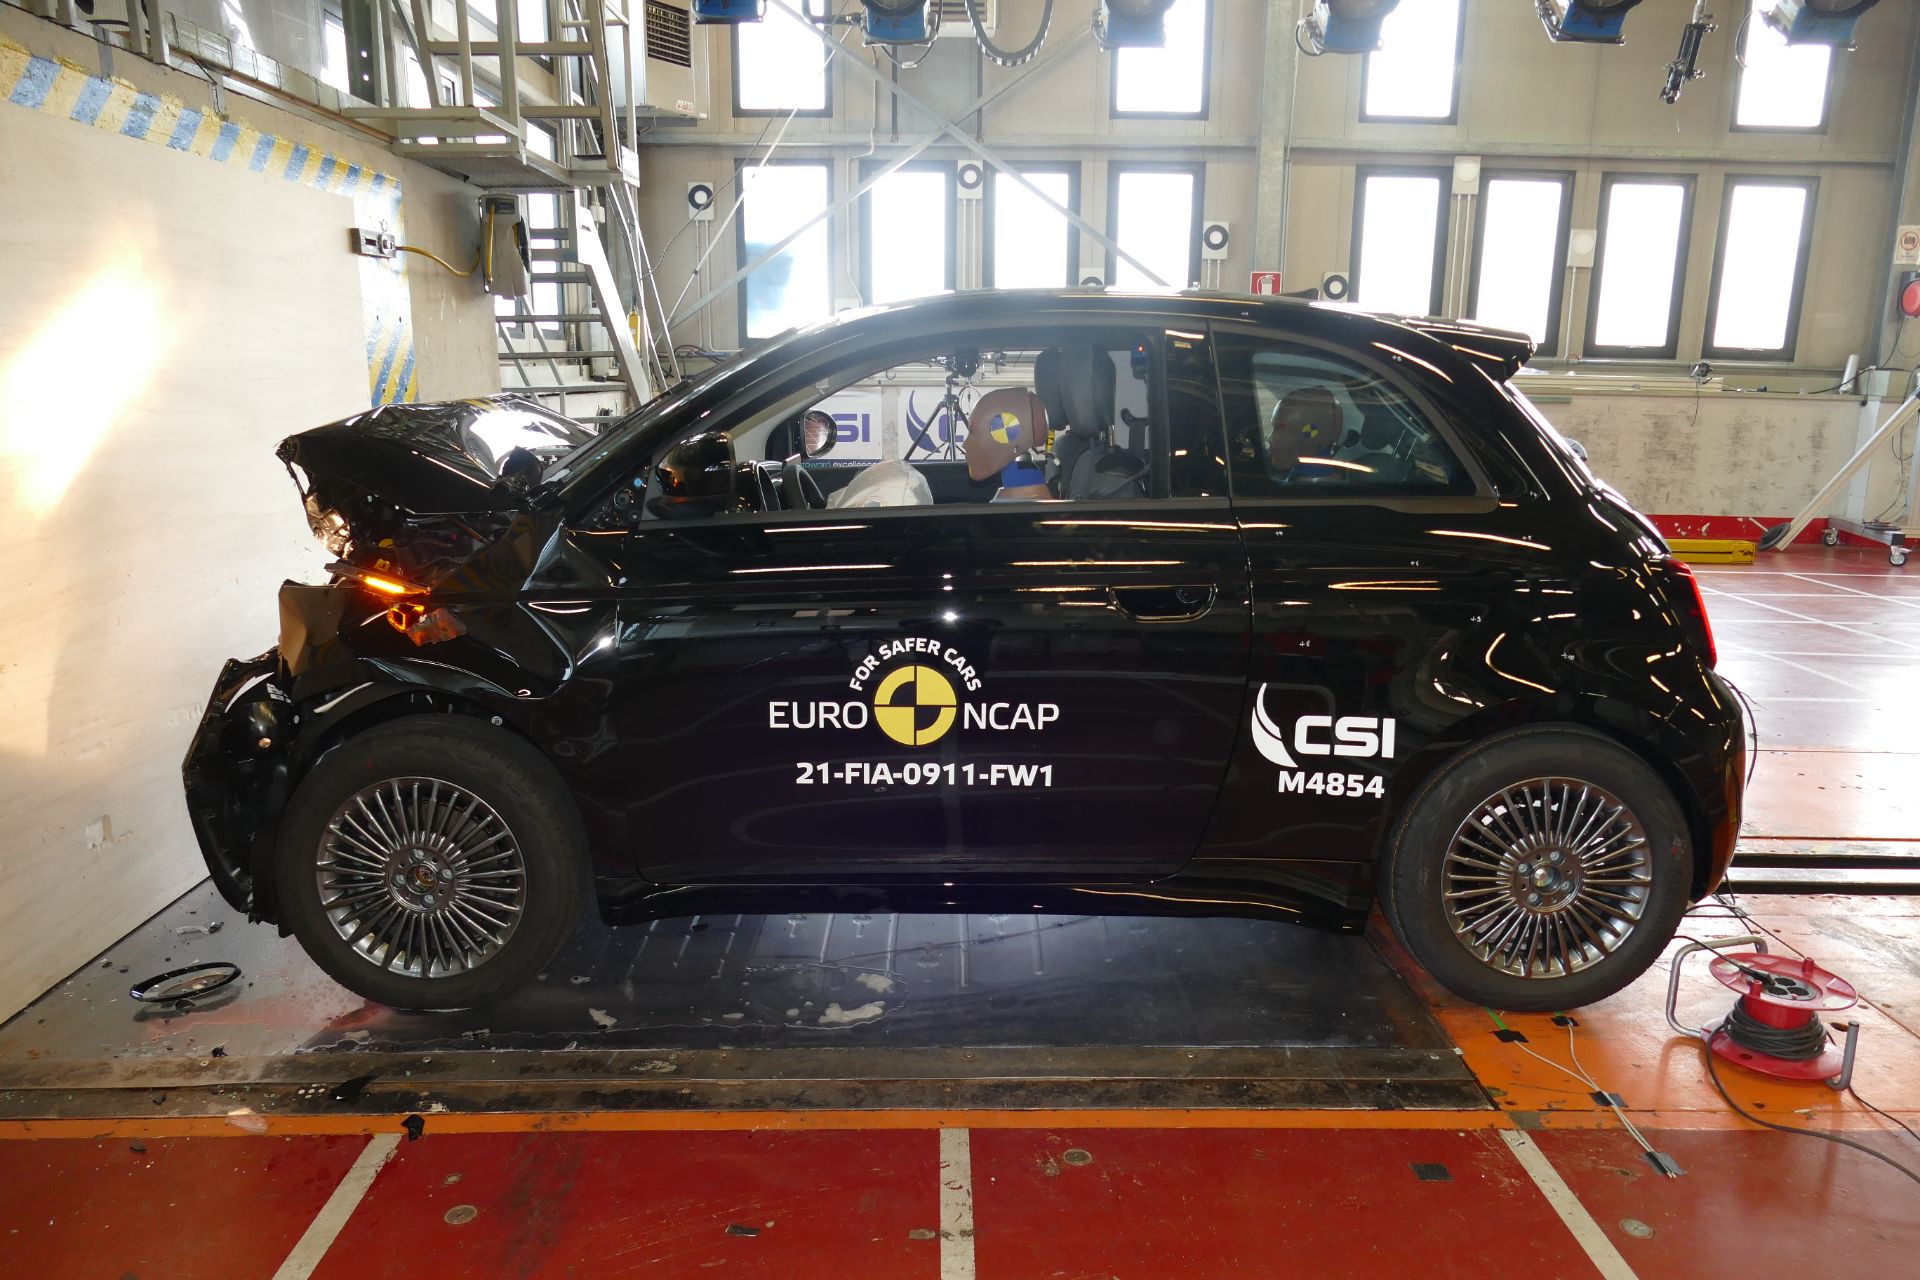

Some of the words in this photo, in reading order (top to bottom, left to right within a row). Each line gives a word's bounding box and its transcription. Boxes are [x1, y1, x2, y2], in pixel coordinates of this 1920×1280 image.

[831, 413, 871, 443] SI
[850, 655, 881, 692] FOR
[879, 638, 941, 661] SAFER
[943, 648, 982, 692] CARS
[769, 701, 868, 729] EURO
[963, 702, 1060, 730] NCAP
[1294, 715, 1396, 759] CSI
[795, 761, 1053, 787] 21-FIA-0911-FW1
[1278, 770, 1385, 799] M4854
